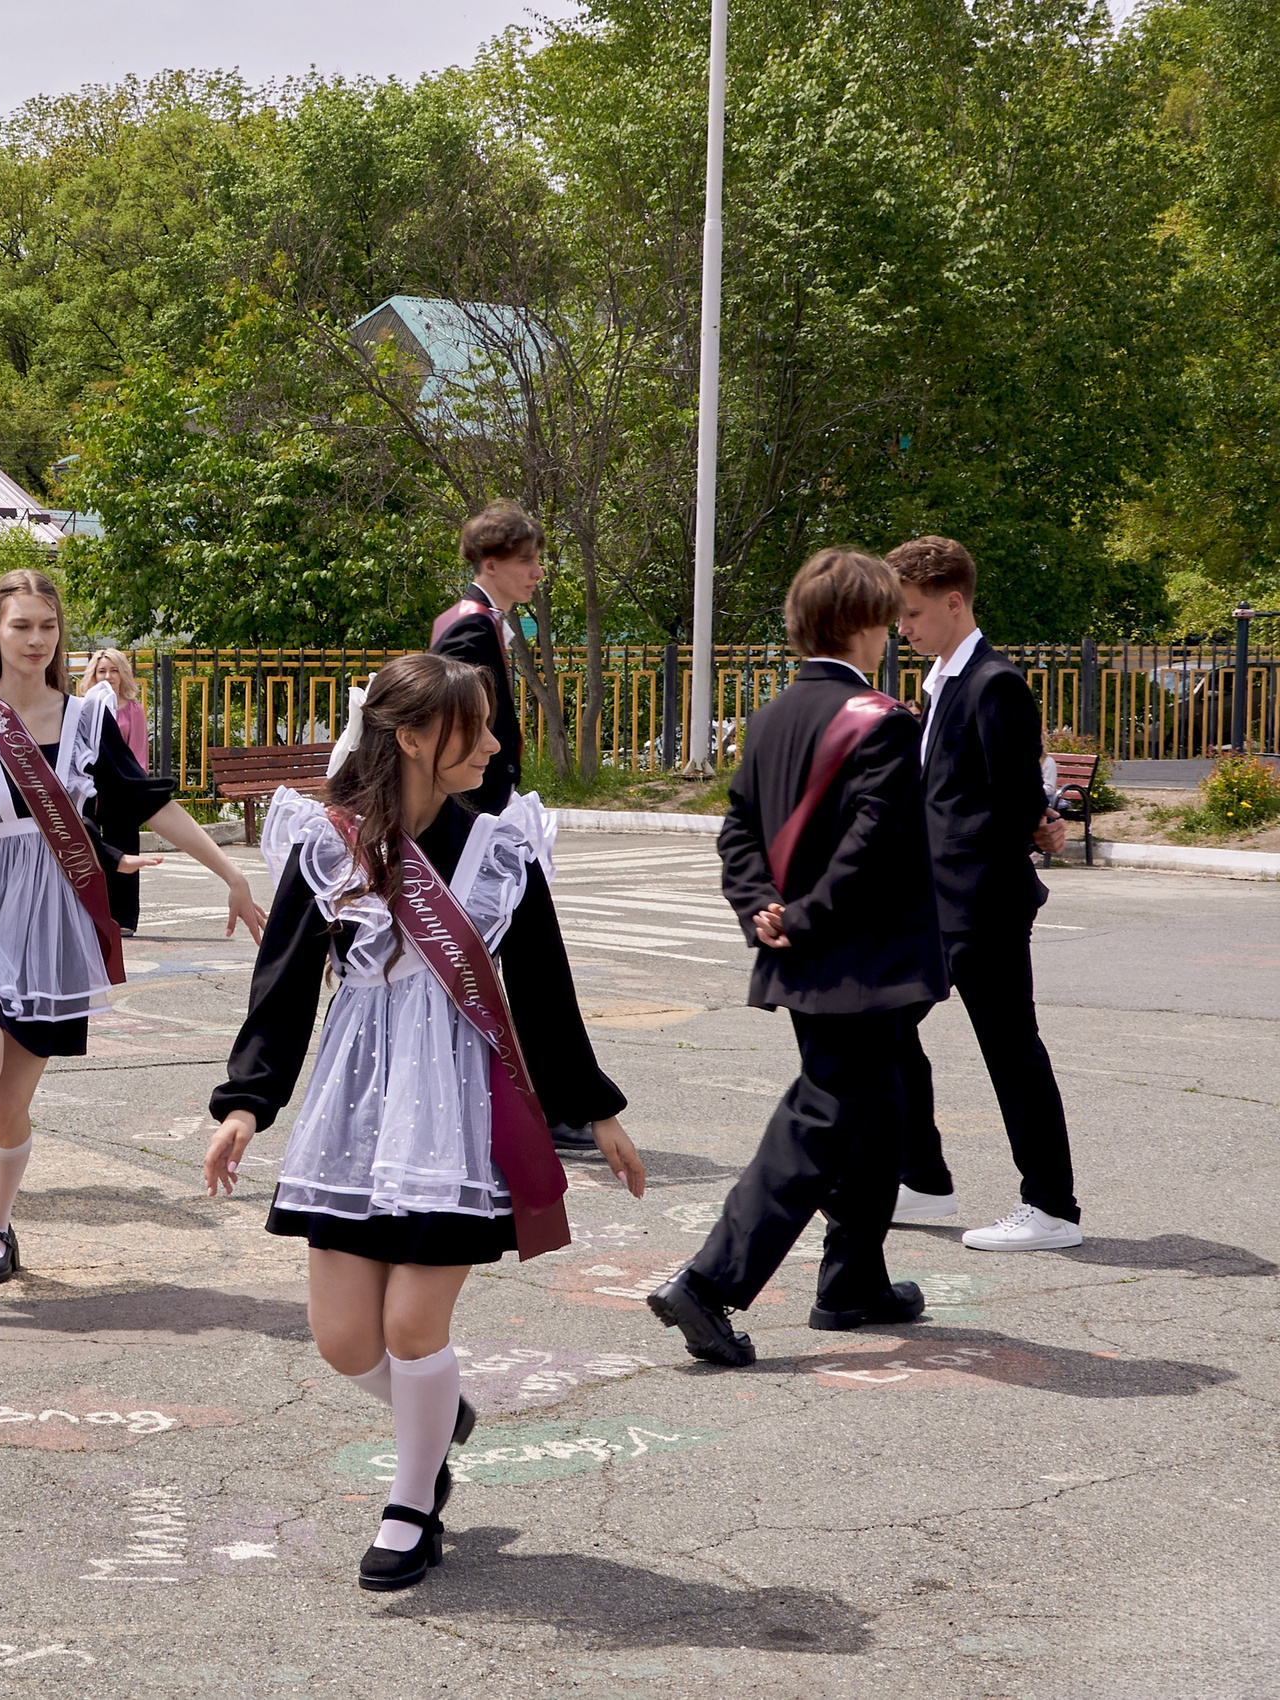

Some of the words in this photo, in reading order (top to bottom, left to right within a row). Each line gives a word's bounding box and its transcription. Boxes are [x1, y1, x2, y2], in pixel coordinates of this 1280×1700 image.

[3, 730, 71, 841] Выпускница
[58, 842, 99, 890] 2026
[401, 859, 491, 1019] Выпускница
